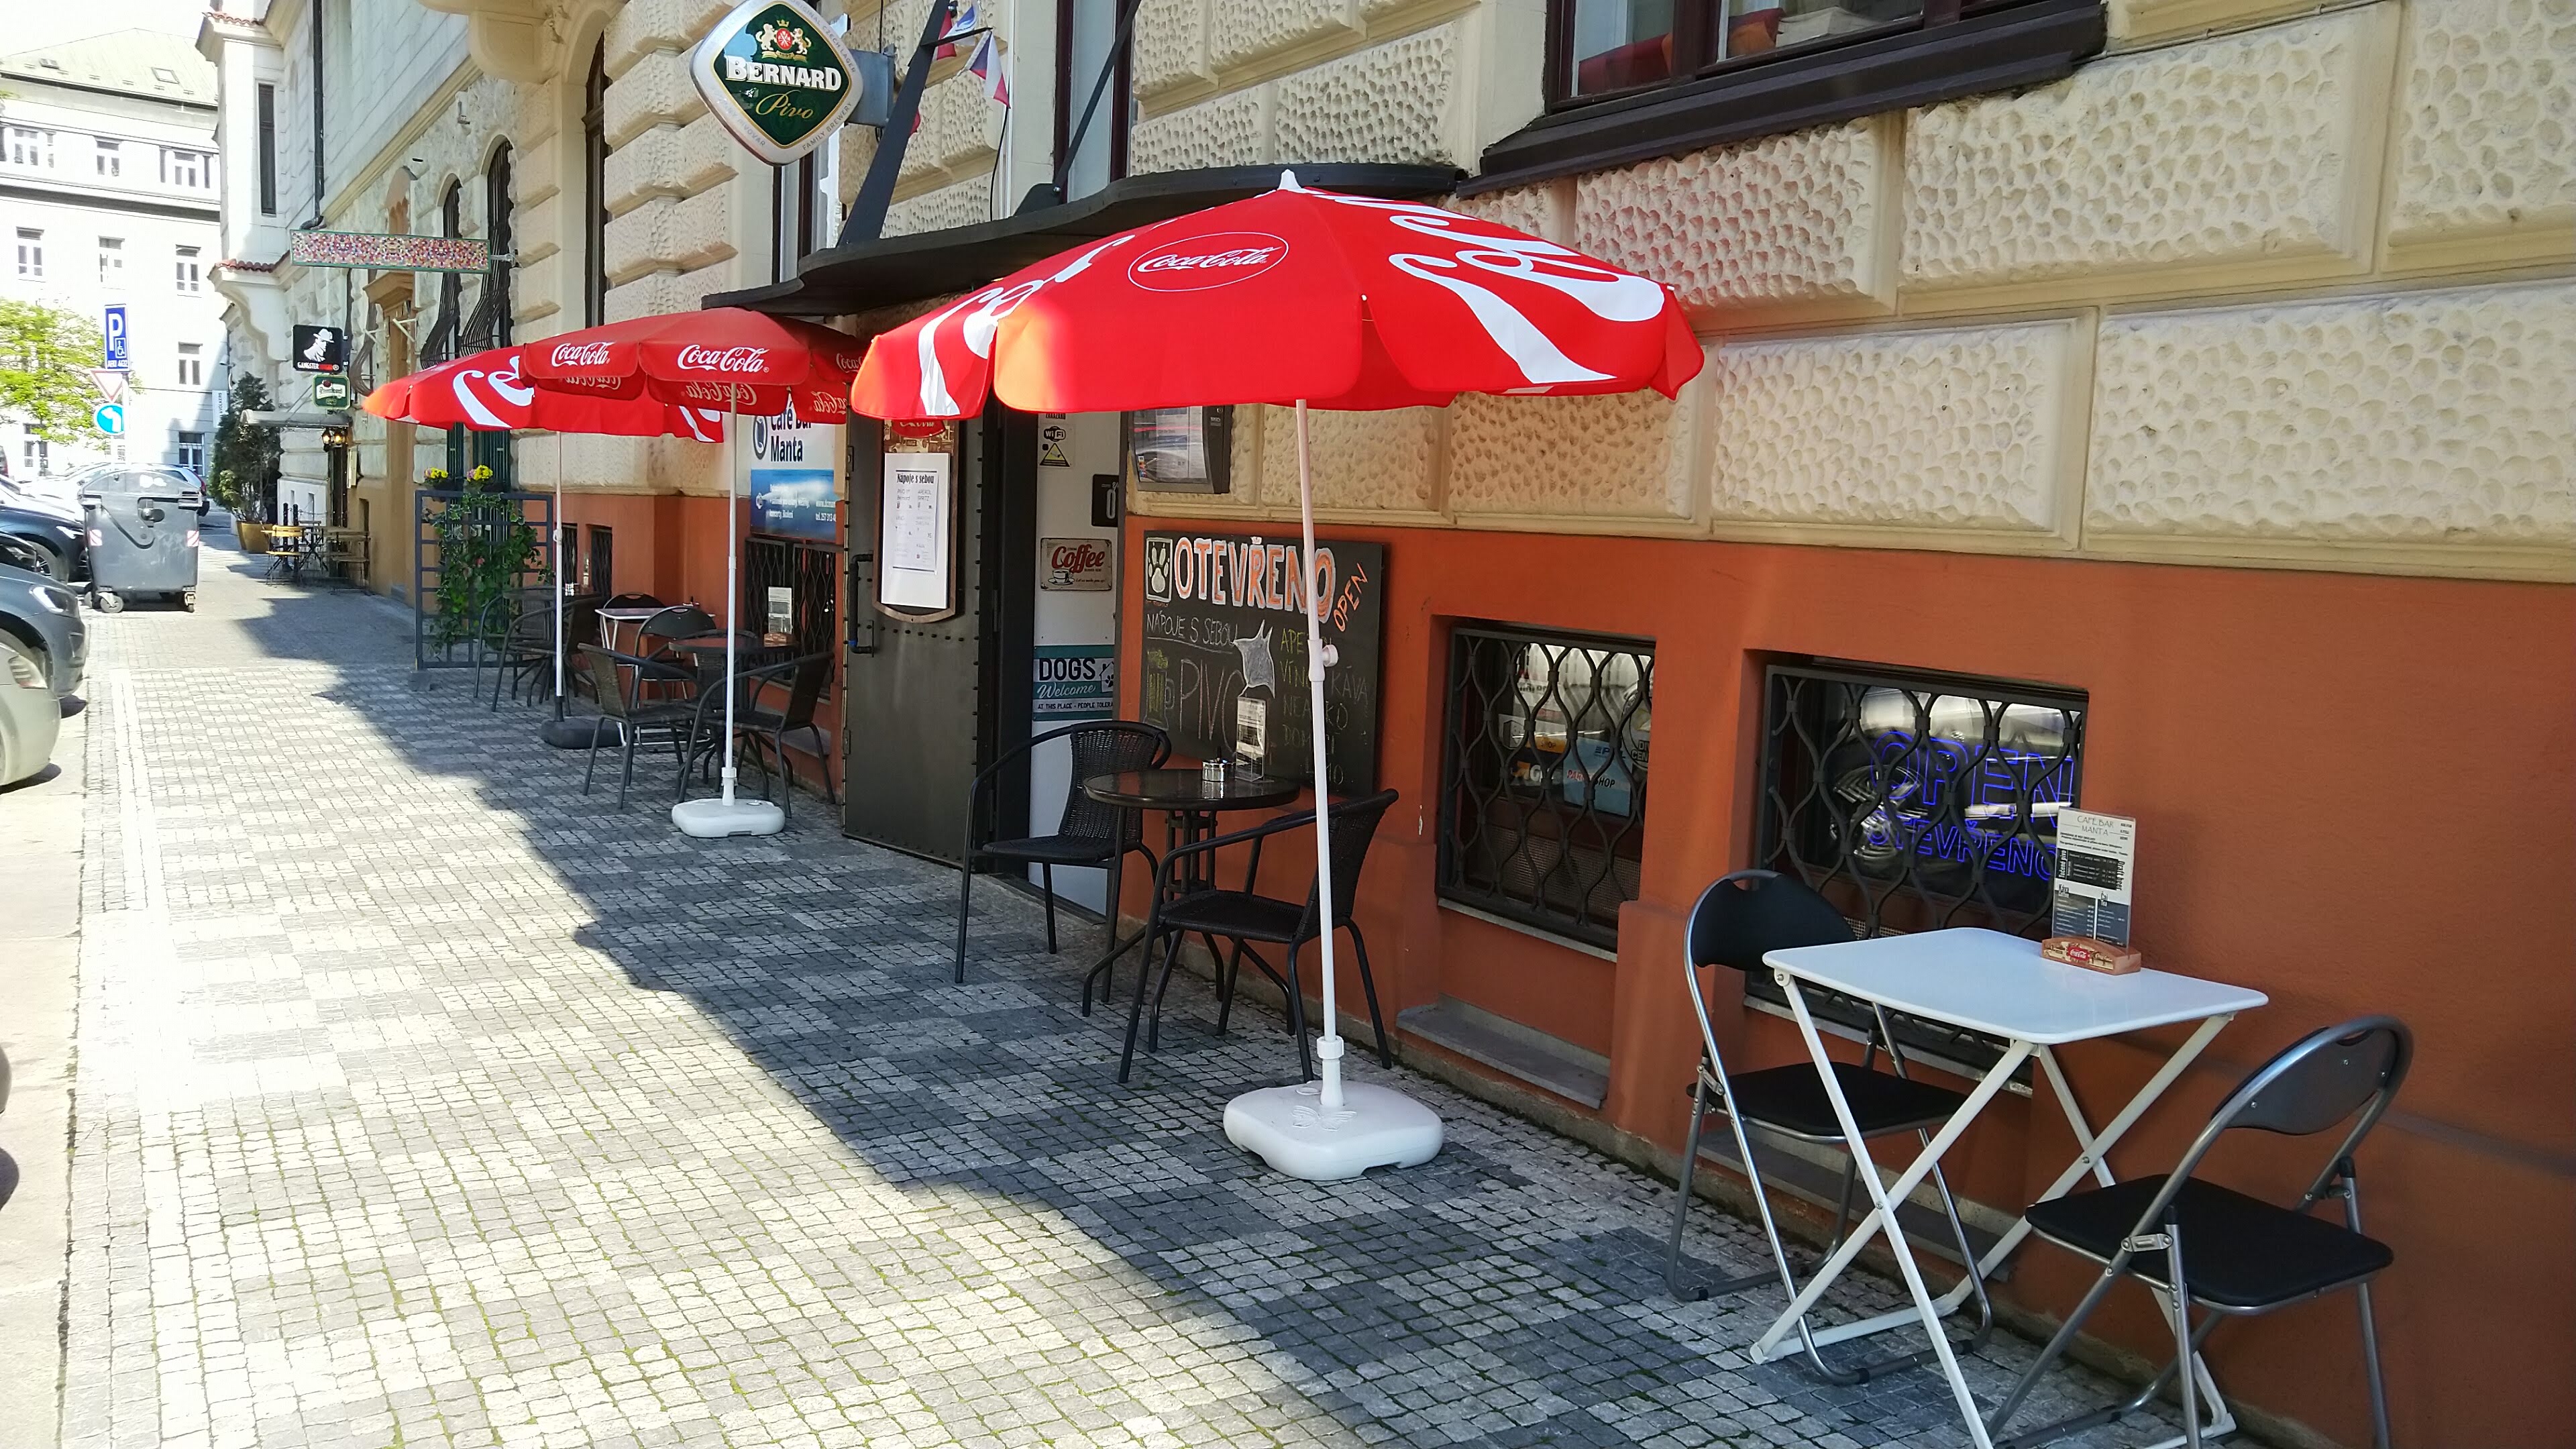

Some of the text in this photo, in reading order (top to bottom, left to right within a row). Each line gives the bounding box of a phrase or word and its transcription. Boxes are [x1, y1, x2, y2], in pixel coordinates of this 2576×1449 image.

[822, 25, 841, 48] CZECH
[841, 48, 856, 72] LAGER
[724, 55, 842, 93] BERNARD
[756, 89, 814, 119] Pivo
[802, 102, 853, 150] FAMILY BREWERY
[1137, 246, 1283, 272] Coca-Cola
[108, 313, 123, 352] P
[297, 362, 319, 370] GANGSTER
[551, 341, 616, 367] Coca-Cola
[677, 344, 769, 373] Coca-Cola
[771, 436, 803, 462] Manta
[897, 473, 914, 484] Nápoje
[919, 474, 934, 484] sebou
[1051, 543, 1106, 574] Coffee
[1174, 537, 1336, 624] OTEVŘENO
[1333, 562, 1368, 633] OPEN
[1146, 609, 1238, 647] NÁPOJE S SEBOU
[1038, 657, 1095, 681] DOGS
[1036, 682, 1096, 699] Welcome
[1870, 731, 2075, 828] OPEN
[2082, 825, 2109, 837] MANTA
[2098, 819, 2114, 828] BAR
[2116, 877, 2125, 891] beer
